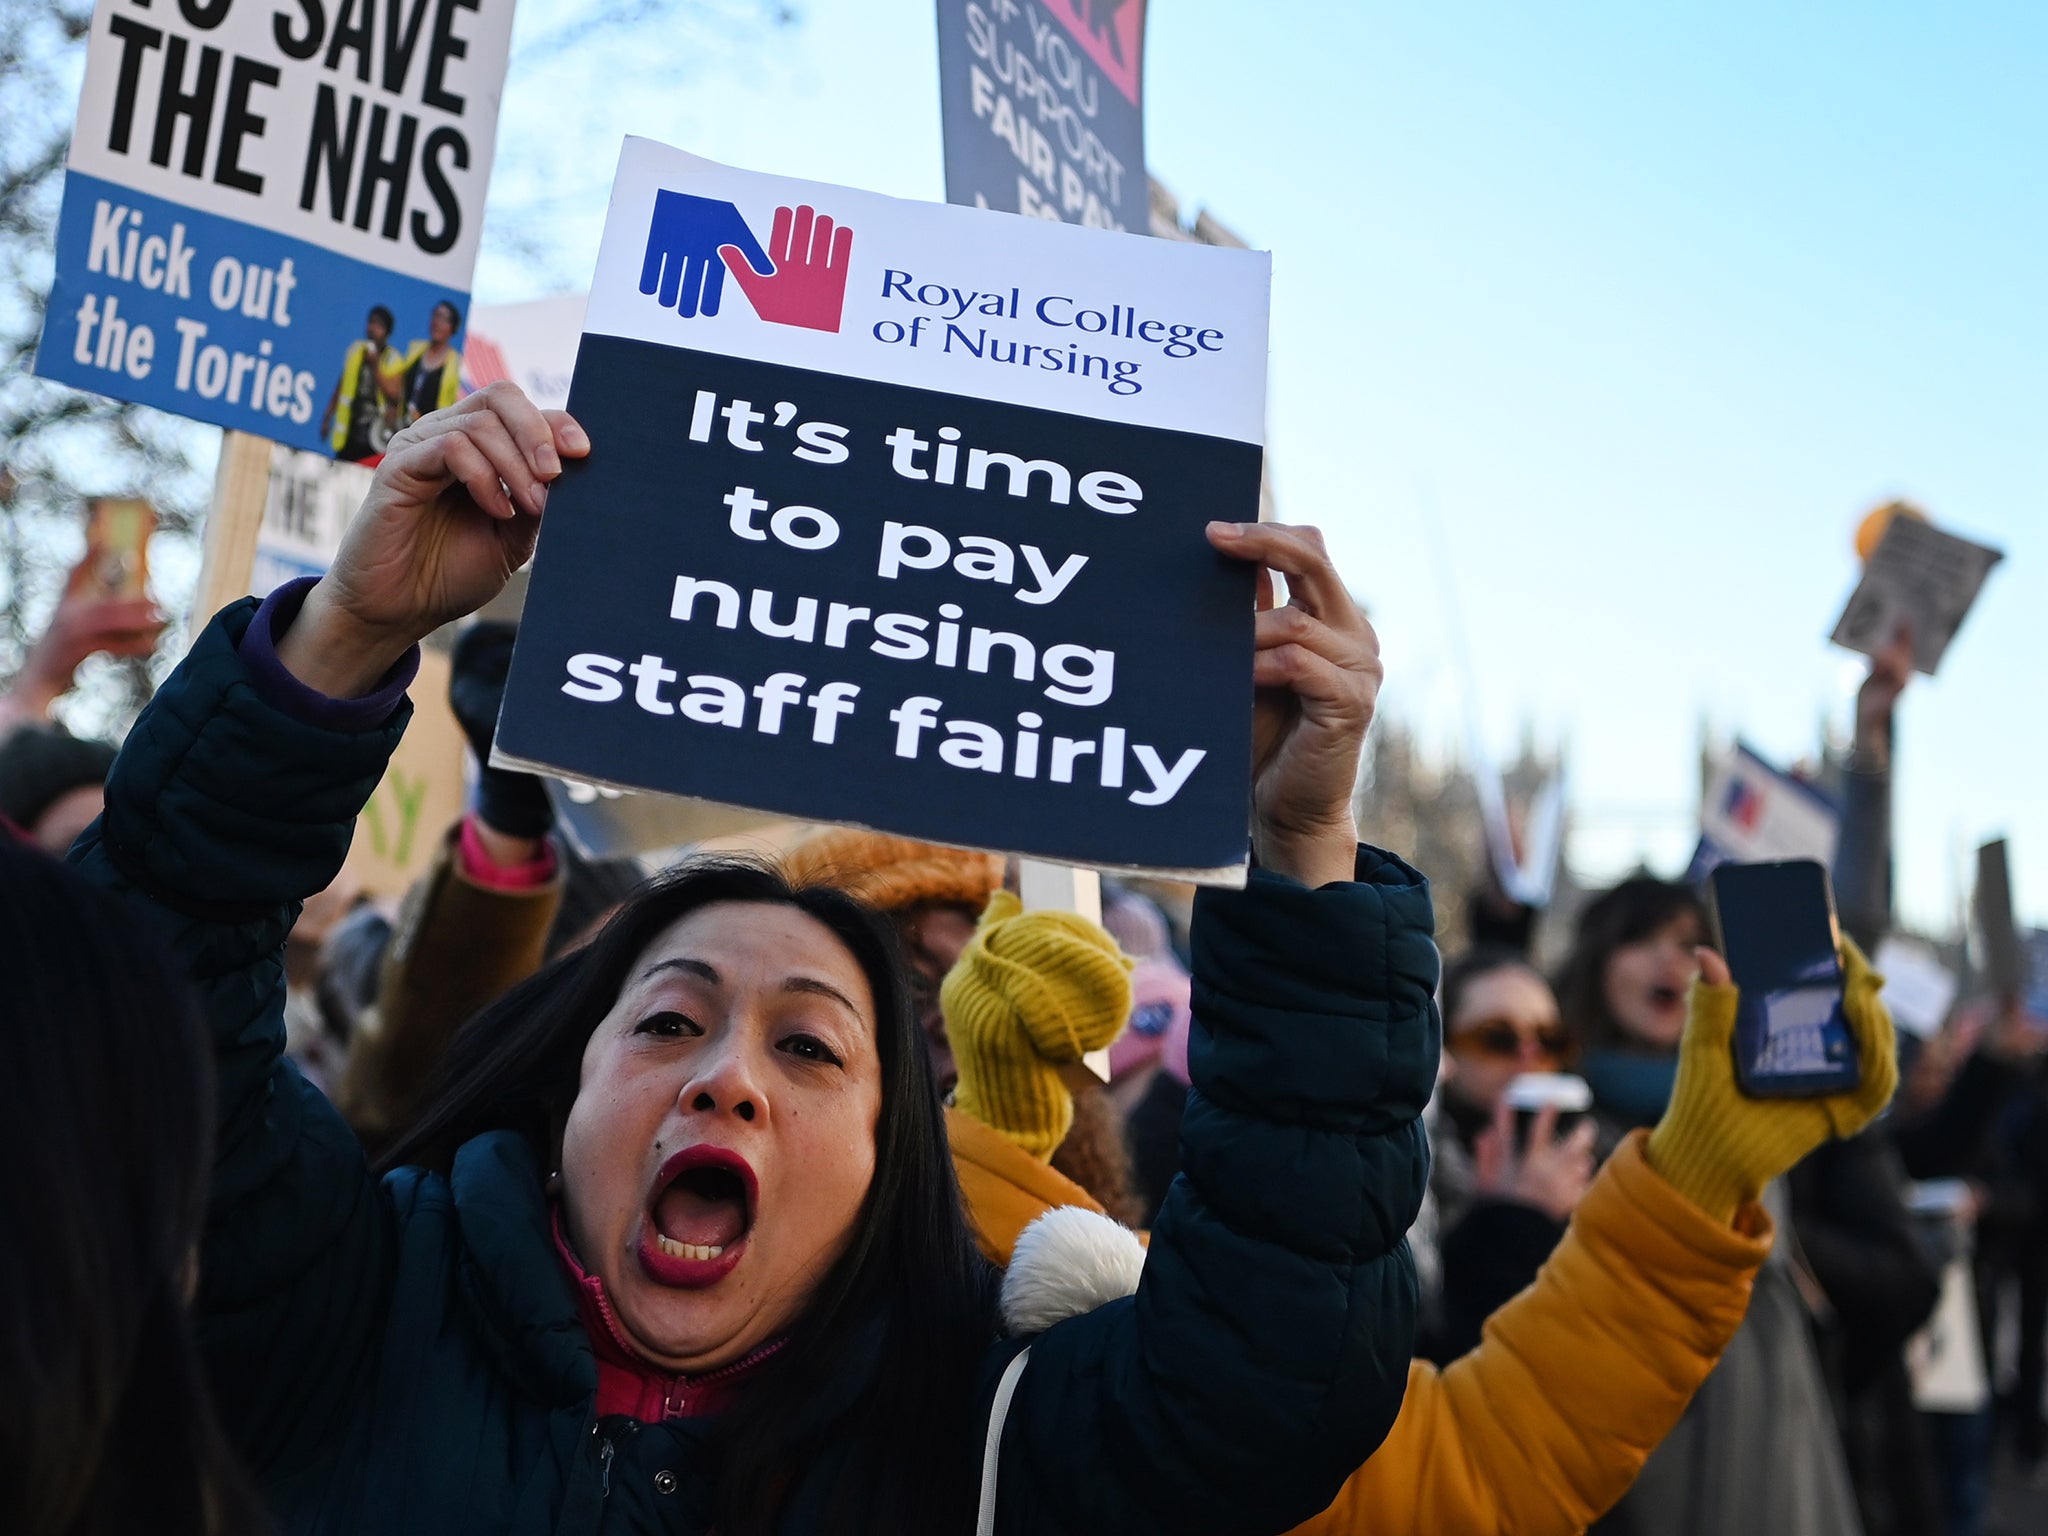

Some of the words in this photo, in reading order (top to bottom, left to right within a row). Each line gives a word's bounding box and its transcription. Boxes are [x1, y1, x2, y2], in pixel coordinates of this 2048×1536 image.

[965, 2, 1126, 207] SUPPORT
[1026, 3, 1099, 118] YOU
[108, 14, 281, 196] THE
[299, 83, 470, 256] NHS
[969, 64, 1058, 195] FAIR
[1060, 161, 1127, 232] PA
[87, 199, 196, 299] Kick
[210, 256, 297, 327] out
[880, 268, 1020, 321] Royal
[1035, 296, 1226, 360] College
[73, 293, 155, 380] the
[175, 316, 316, 424] Tories
[872, 316, 933, 348] of
[942, 323, 1143, 396] Nursing
[885, 426, 1144, 515] time
[722, 485, 841, 551] to
[877, 519, 1091, 605] pay
[669, 574, 1116, 707] nursing
[560, 652, 862, 746] staff
[888, 696, 1208, 807] fairly
